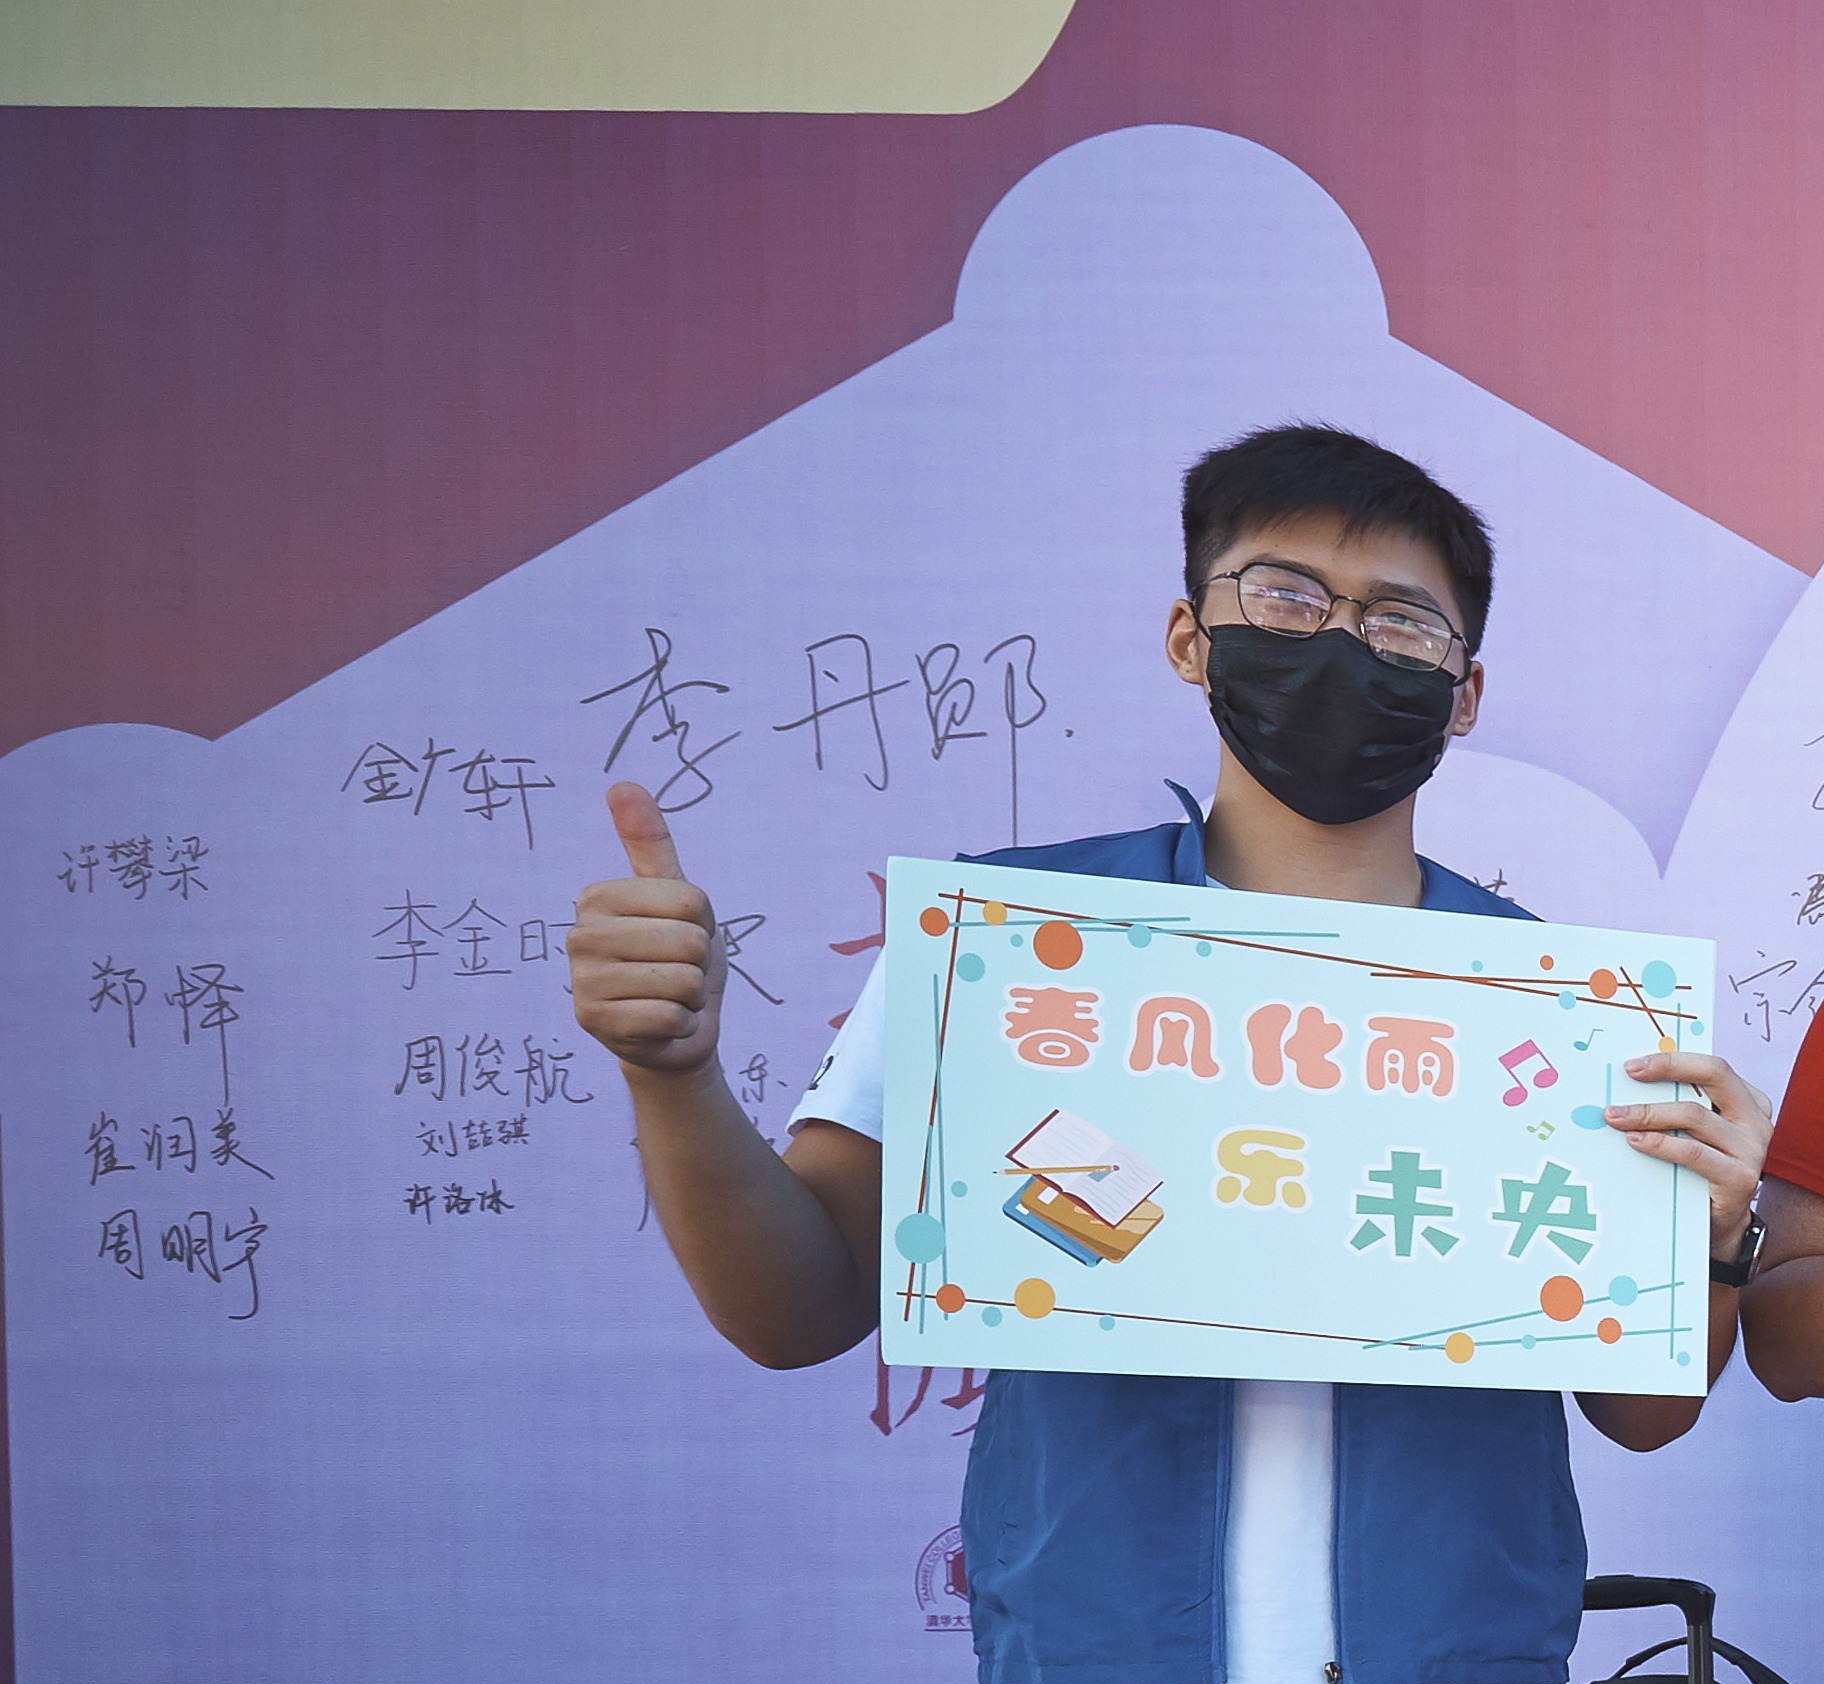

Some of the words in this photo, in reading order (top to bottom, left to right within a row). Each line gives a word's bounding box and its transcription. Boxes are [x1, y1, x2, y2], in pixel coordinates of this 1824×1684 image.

[394, 1033, 595, 1108] 周俊航
[1003, 986, 1458, 1098] 春风化雨
[1215, 1129, 1598, 1264] 乐未央
